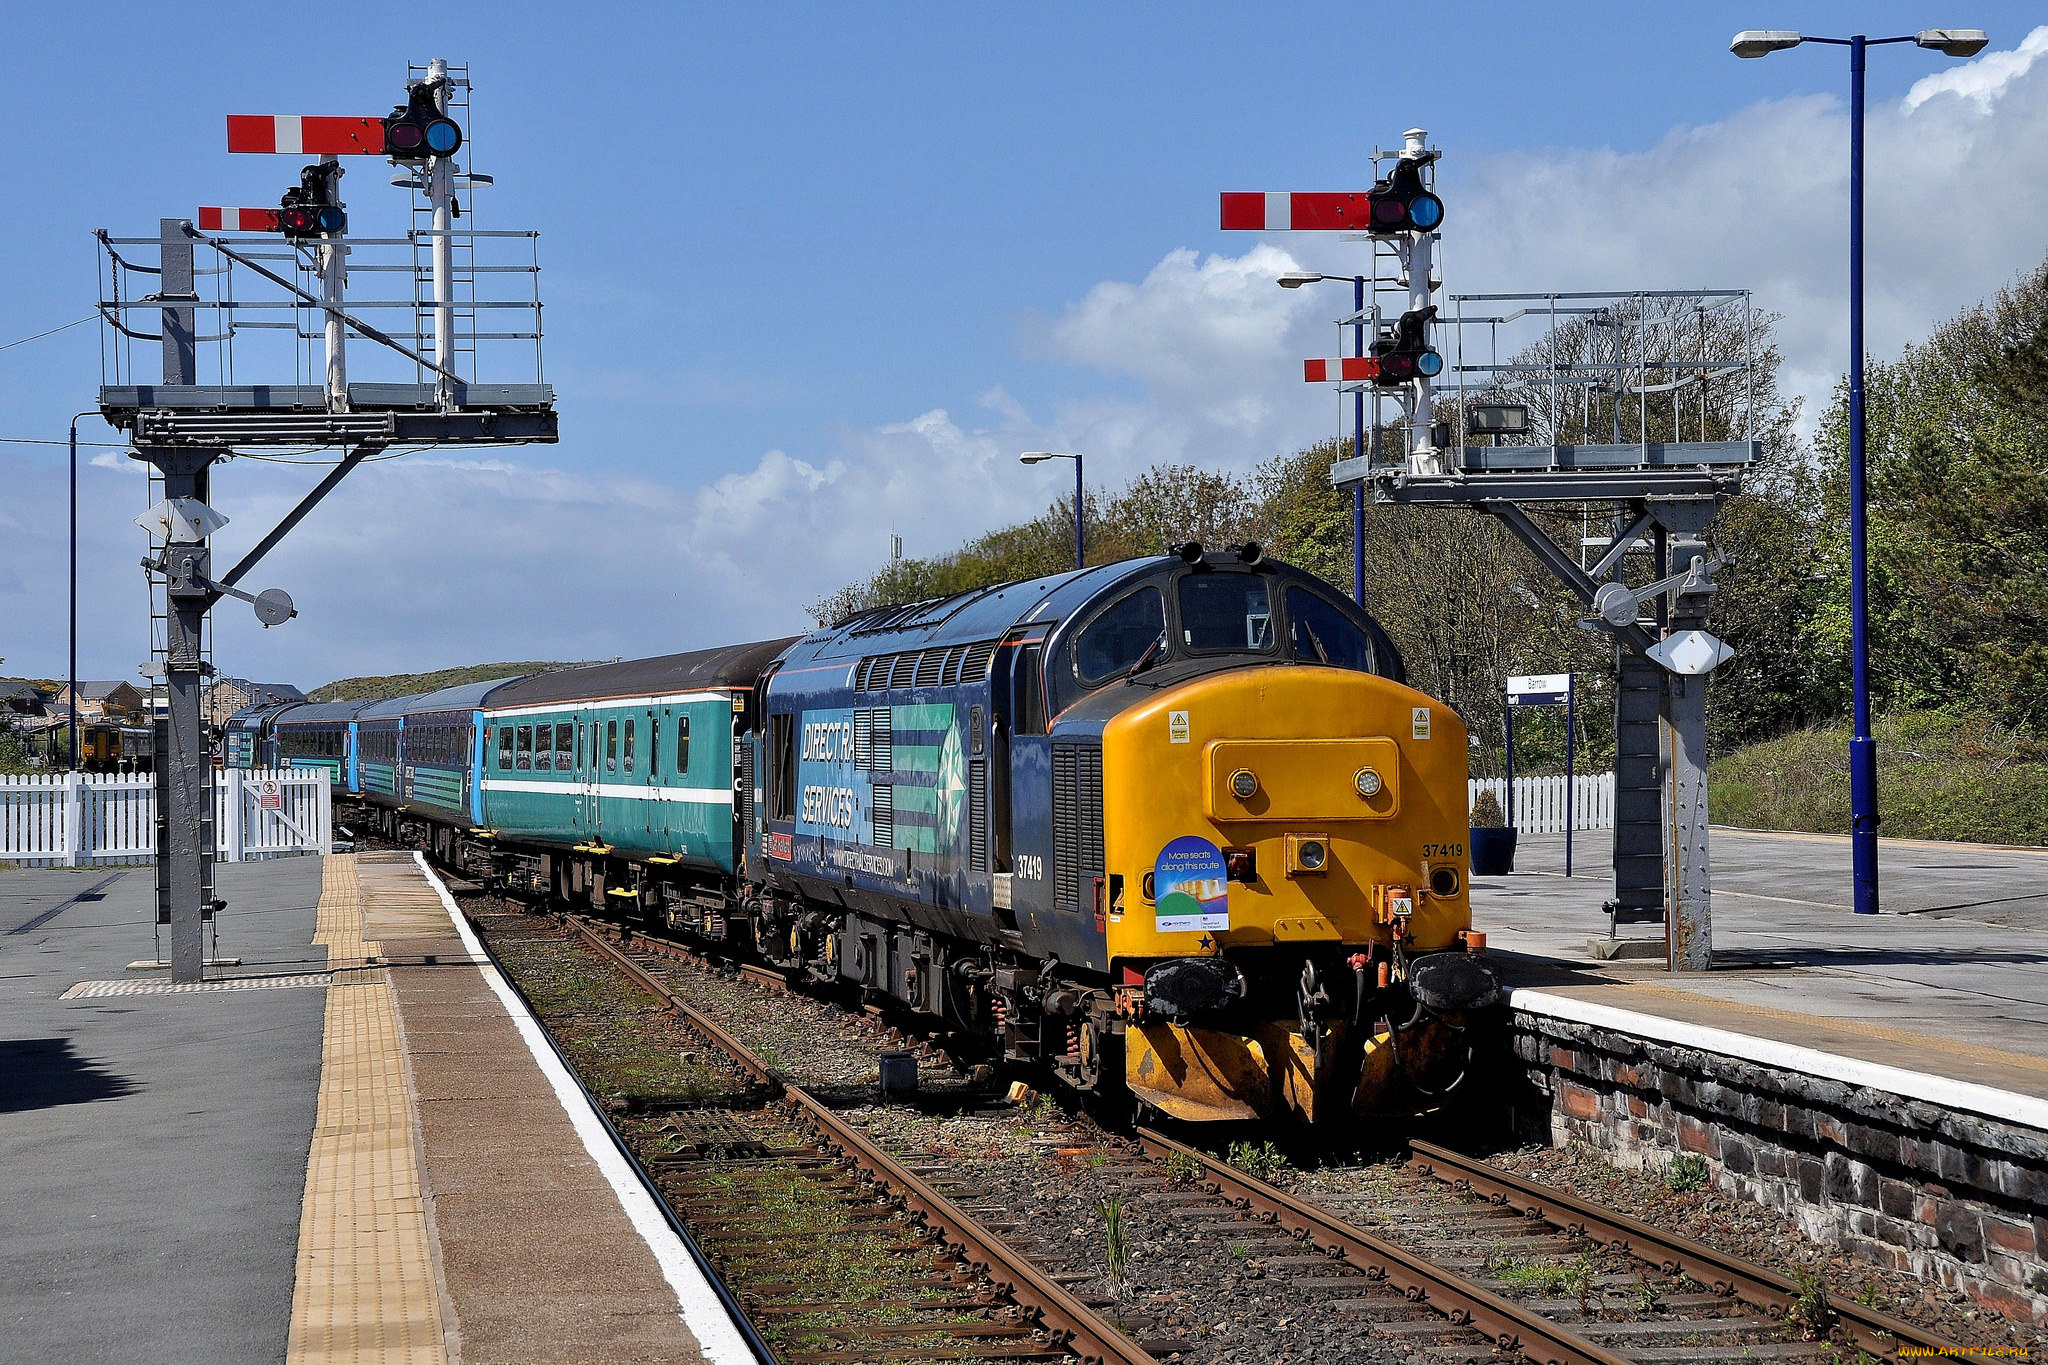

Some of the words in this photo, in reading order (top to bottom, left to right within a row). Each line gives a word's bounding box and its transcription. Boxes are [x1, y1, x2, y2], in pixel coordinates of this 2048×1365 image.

[803, 722, 841, 762] DIRECT
[802, 784, 853, 829] SERVICES
[1168, 852, 1189, 860] More
[1190, 851, 1211, 859] seats
[1422, 843, 1463, 858] 37419
[1018, 854, 1042, 881] 37419
[1161, 862, 1184, 872] along
[1185, 861, 1198, 870] this
[1199, 861, 1220, 870] route
